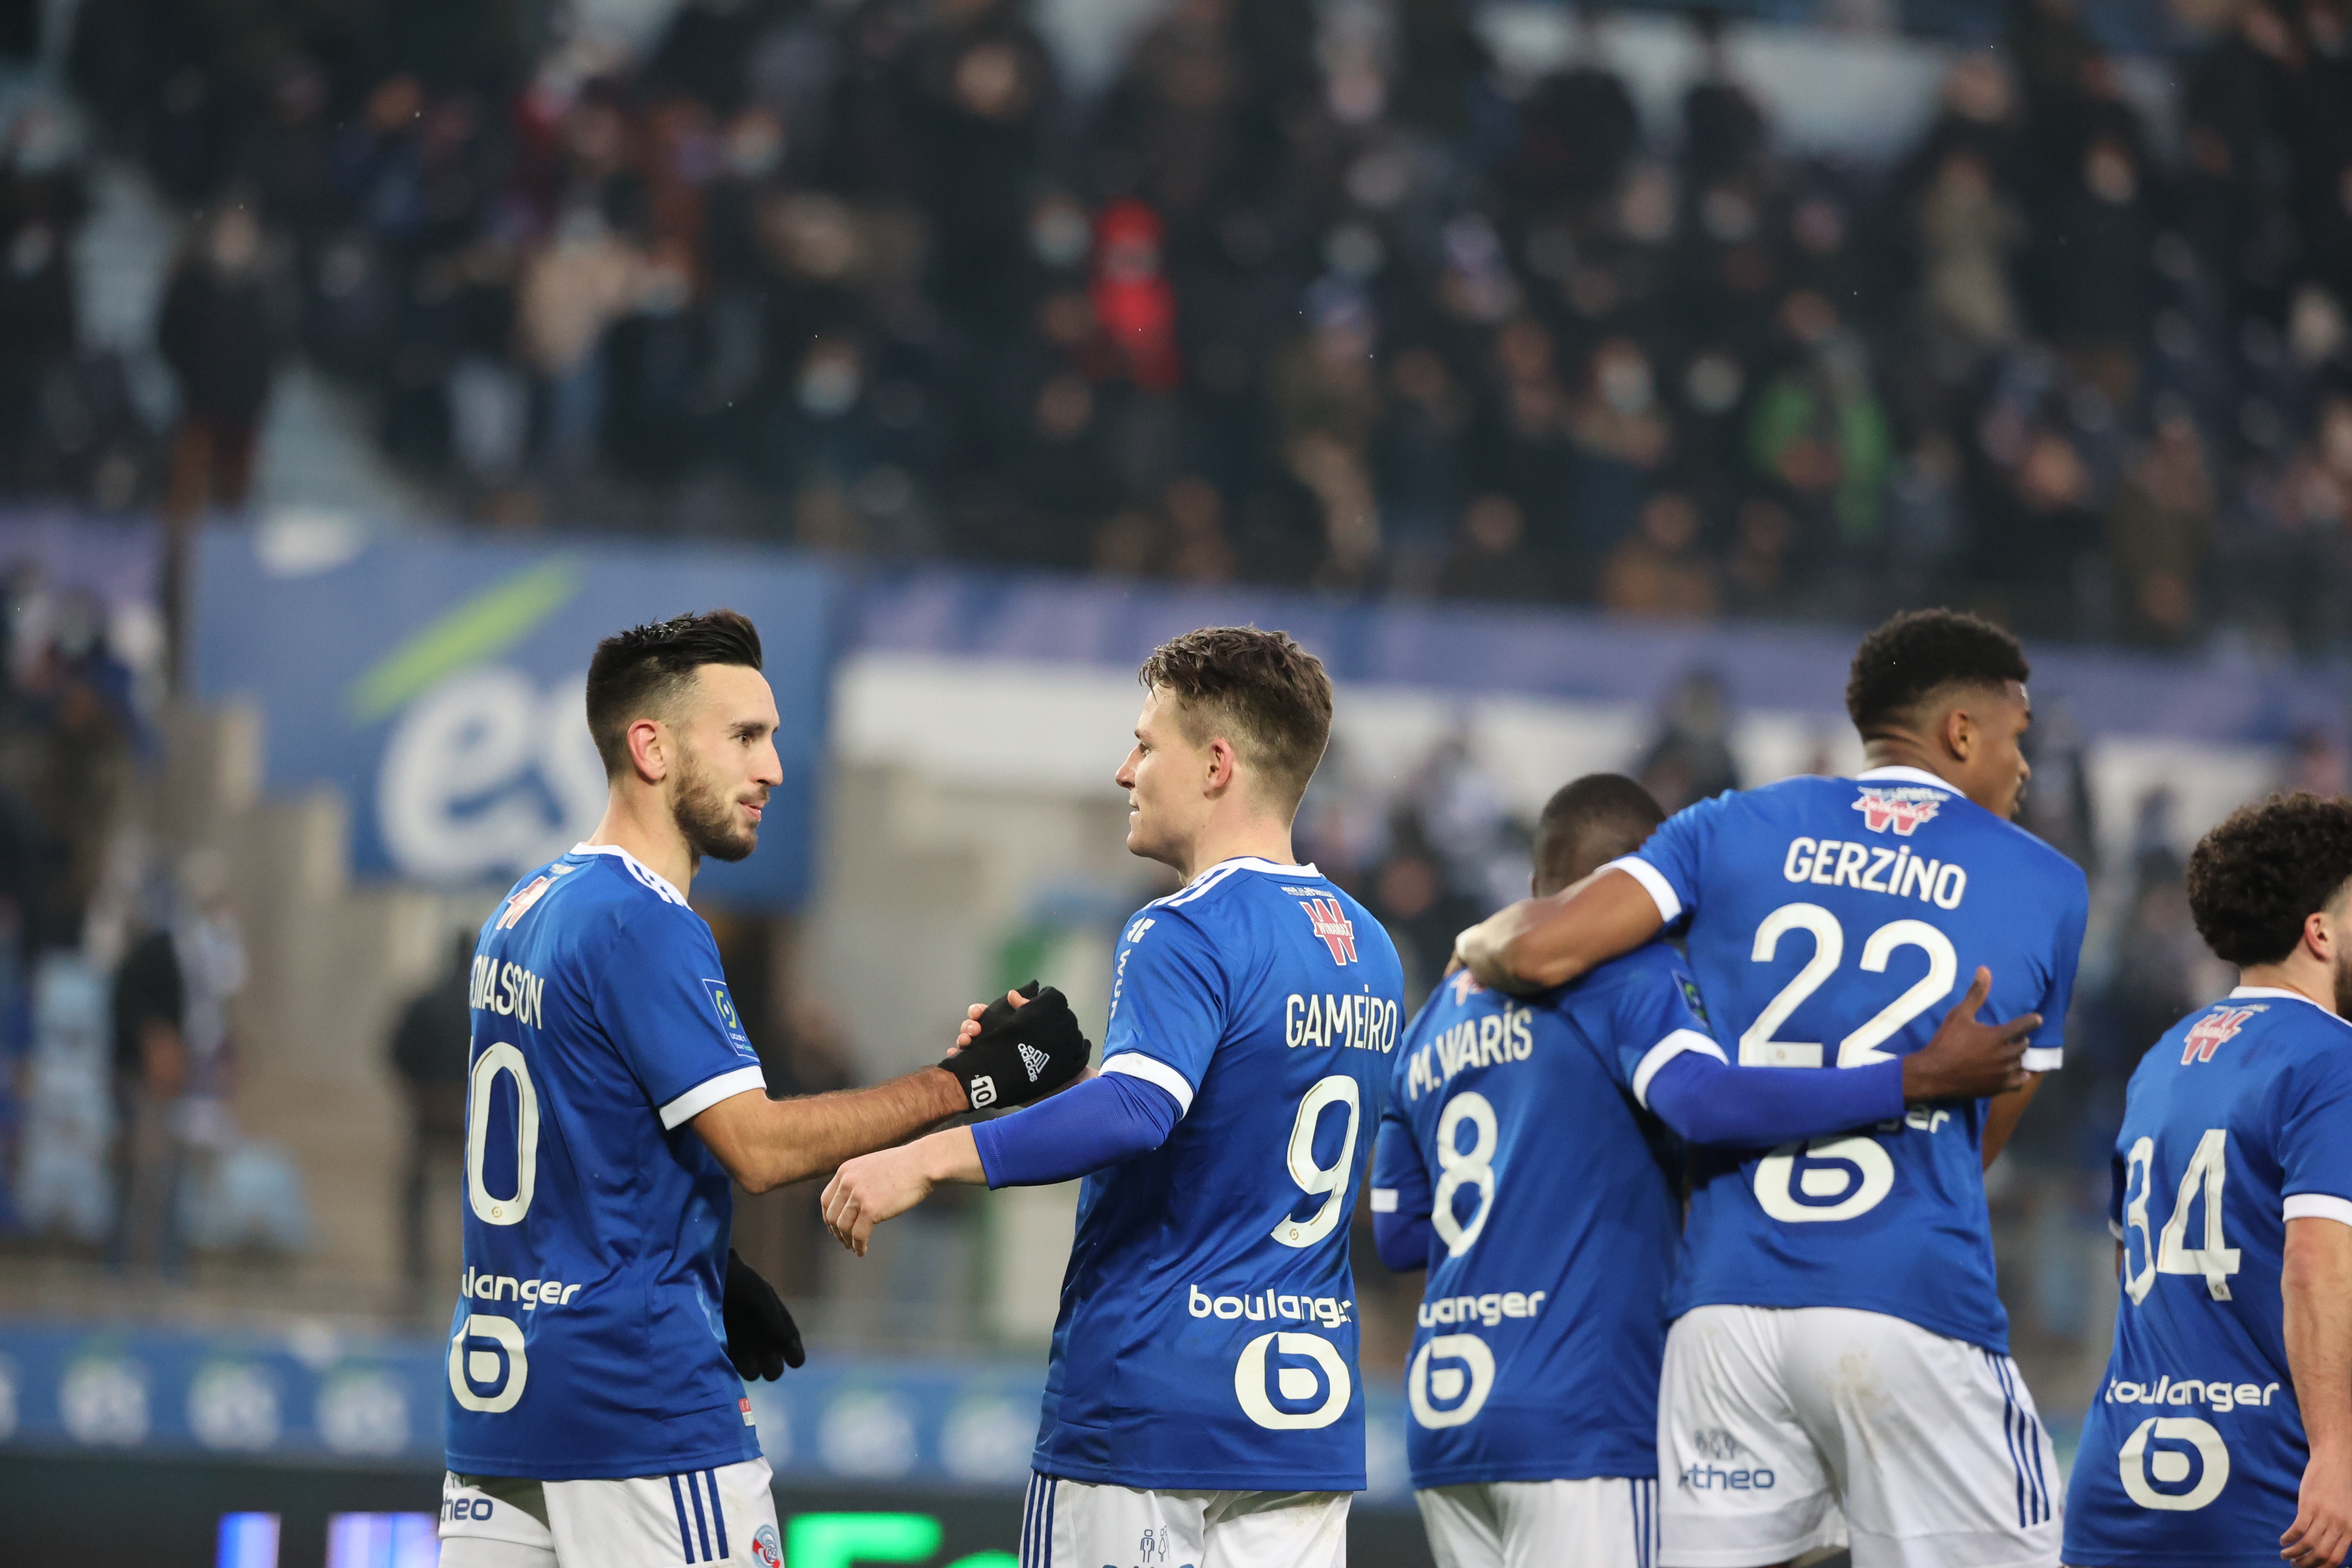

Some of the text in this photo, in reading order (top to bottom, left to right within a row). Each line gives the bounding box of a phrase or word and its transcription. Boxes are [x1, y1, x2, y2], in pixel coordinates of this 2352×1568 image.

[1315, 921, 1351, 937] WINAMAX
[1738, 902, 1958, 1069] 22
[467, 1035, 539, 1225] 0
[972, 1080, 992, 1103] 10
[1017, 1043, 1038, 1082] adidas
[1271, 1075, 1359, 1248] 9
[1431, 1091, 1498, 1258] 8
[2124, 1129, 2241, 1307] 34
